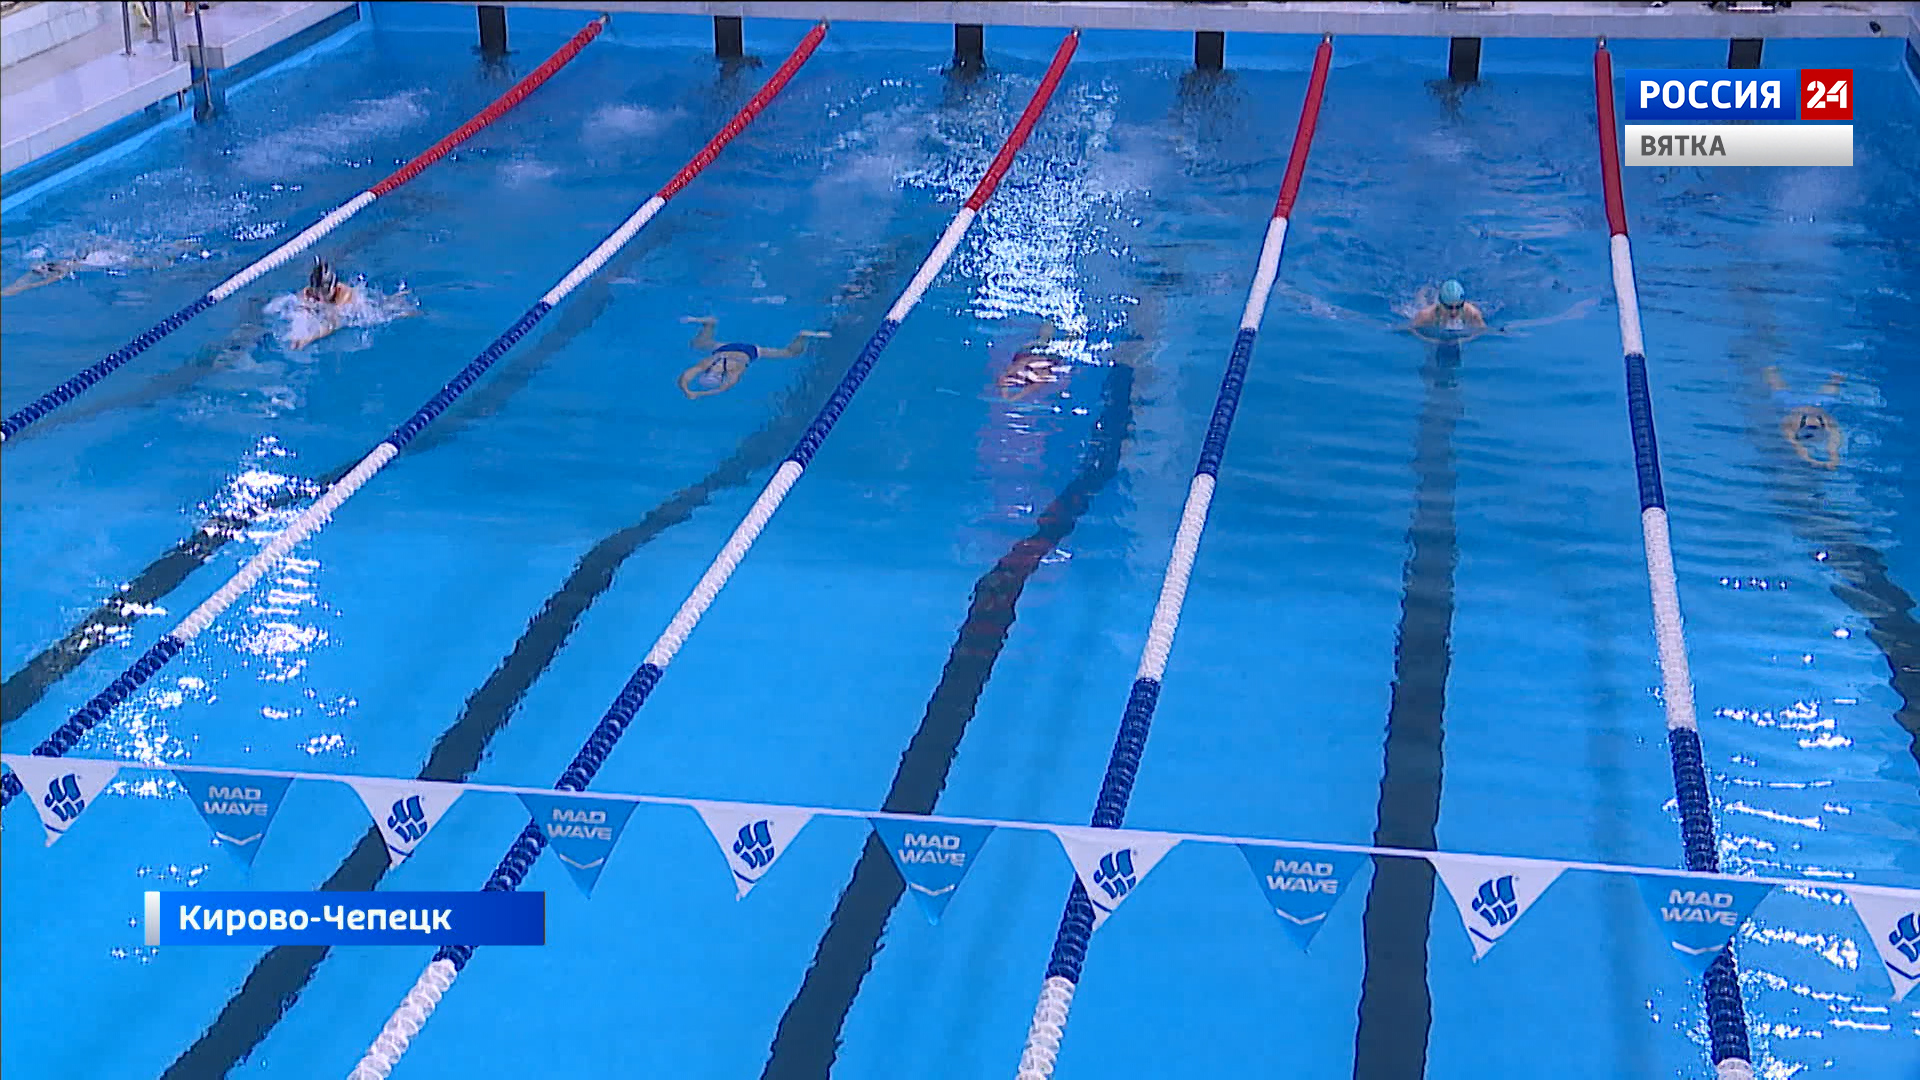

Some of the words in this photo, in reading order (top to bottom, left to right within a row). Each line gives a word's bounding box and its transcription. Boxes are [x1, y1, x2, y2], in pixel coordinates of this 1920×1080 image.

[208, 785, 262, 800] MAD
[203, 801, 268, 816] WAVE
[552, 808, 607, 824] MAD
[546, 824, 613, 841] WAVE
[903, 833, 961, 849] MAD
[898, 849, 966, 867] WAVE
[1273, 859, 1334, 876] MAD
[1266, 875, 1339, 894] WAVE
[1668, 889, 1735, 908] MAD
[1660, 907, 1739, 926] WAVE
